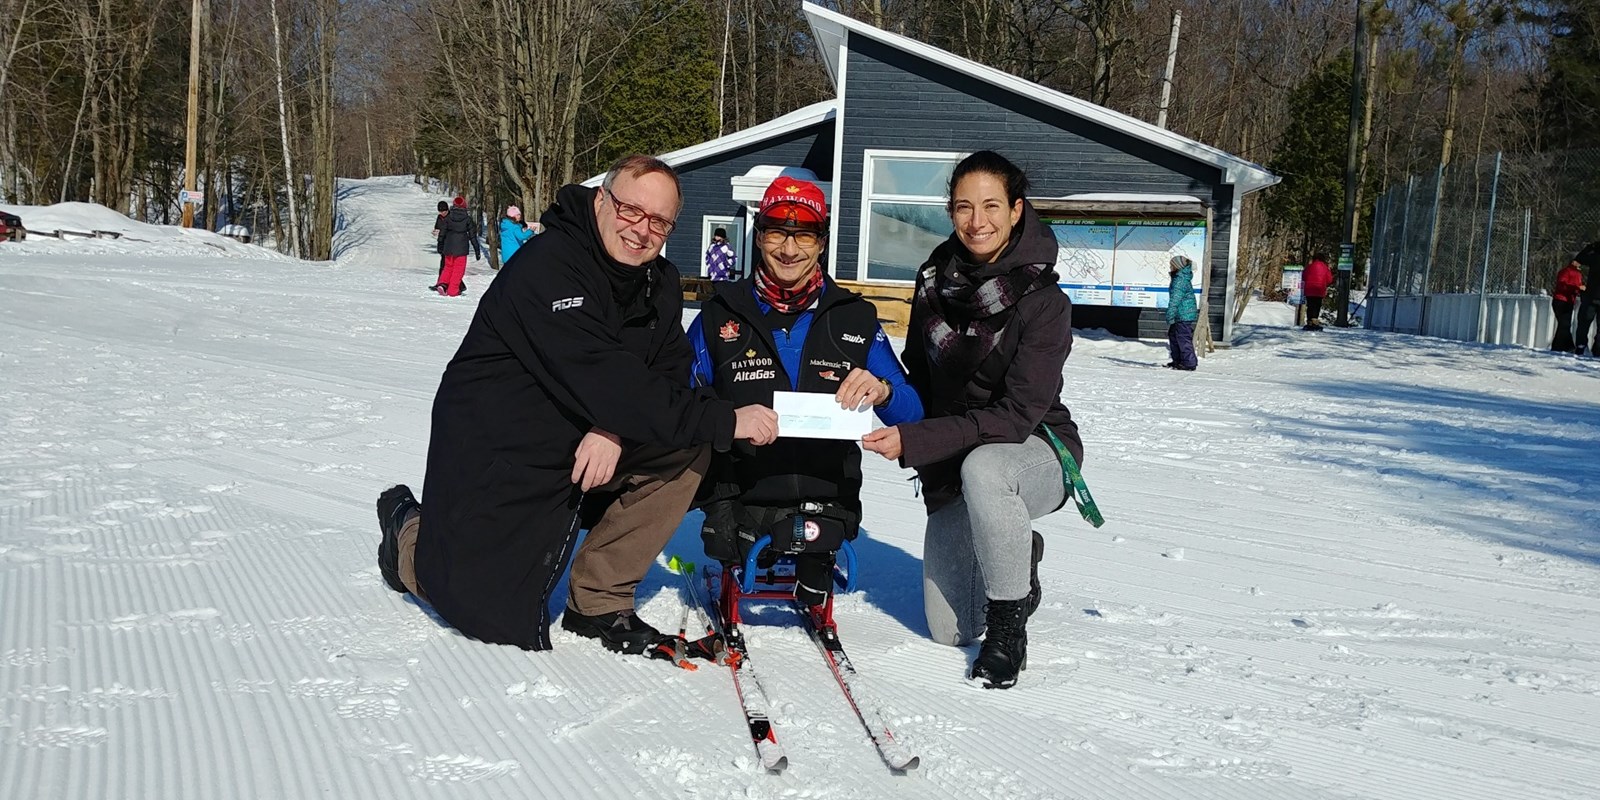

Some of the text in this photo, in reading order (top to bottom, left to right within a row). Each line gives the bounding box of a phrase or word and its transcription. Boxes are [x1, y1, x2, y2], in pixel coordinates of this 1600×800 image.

[762, 195, 822, 212] HAYWOOD
[731, 358, 772, 370] HAYWOOD
[809, 359, 842, 369] Mackenzie
[733, 369, 776, 382] AltaGas
